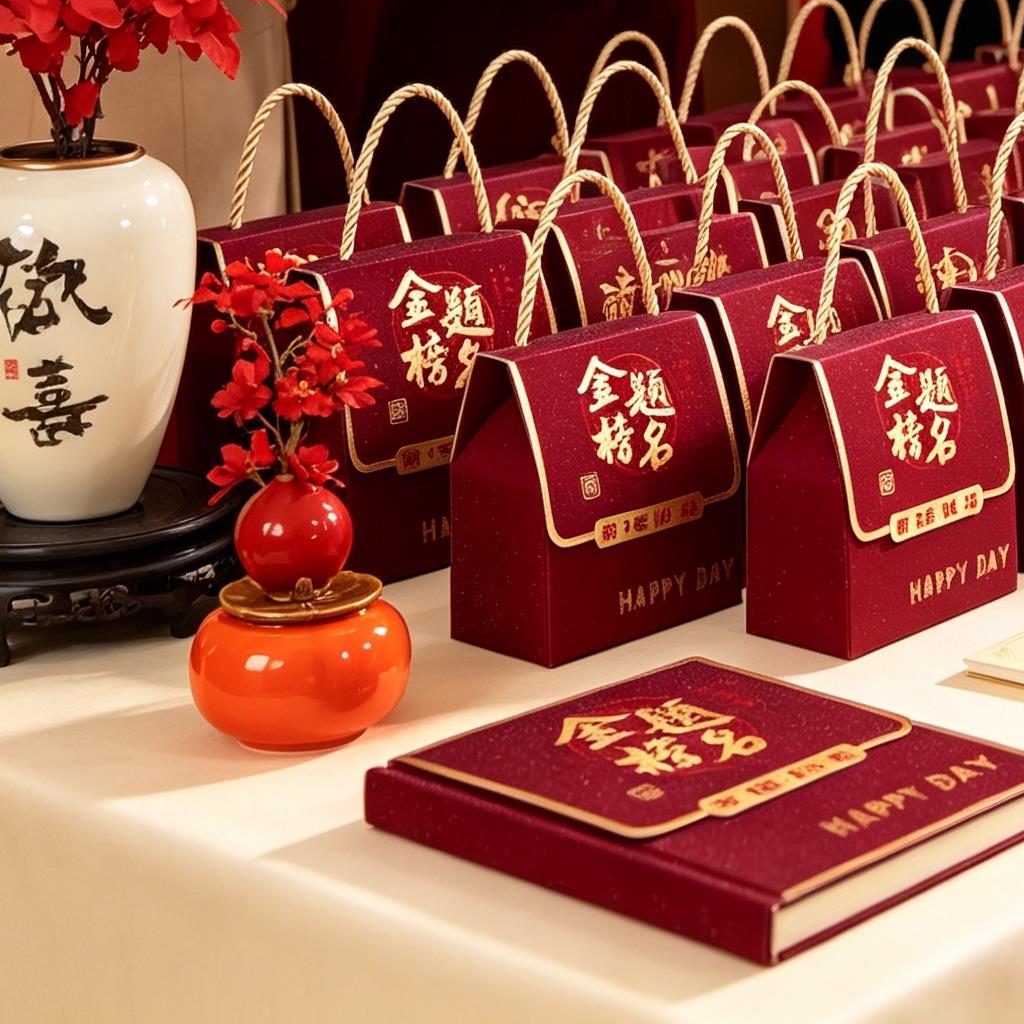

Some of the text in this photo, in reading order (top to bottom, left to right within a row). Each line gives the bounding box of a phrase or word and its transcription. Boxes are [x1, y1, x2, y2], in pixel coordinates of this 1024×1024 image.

[618, 557, 735, 616] HAPPY DAY
[909, 543, 1010, 606] HAPPY DAY
[925, 754, 998, 792] DAY
